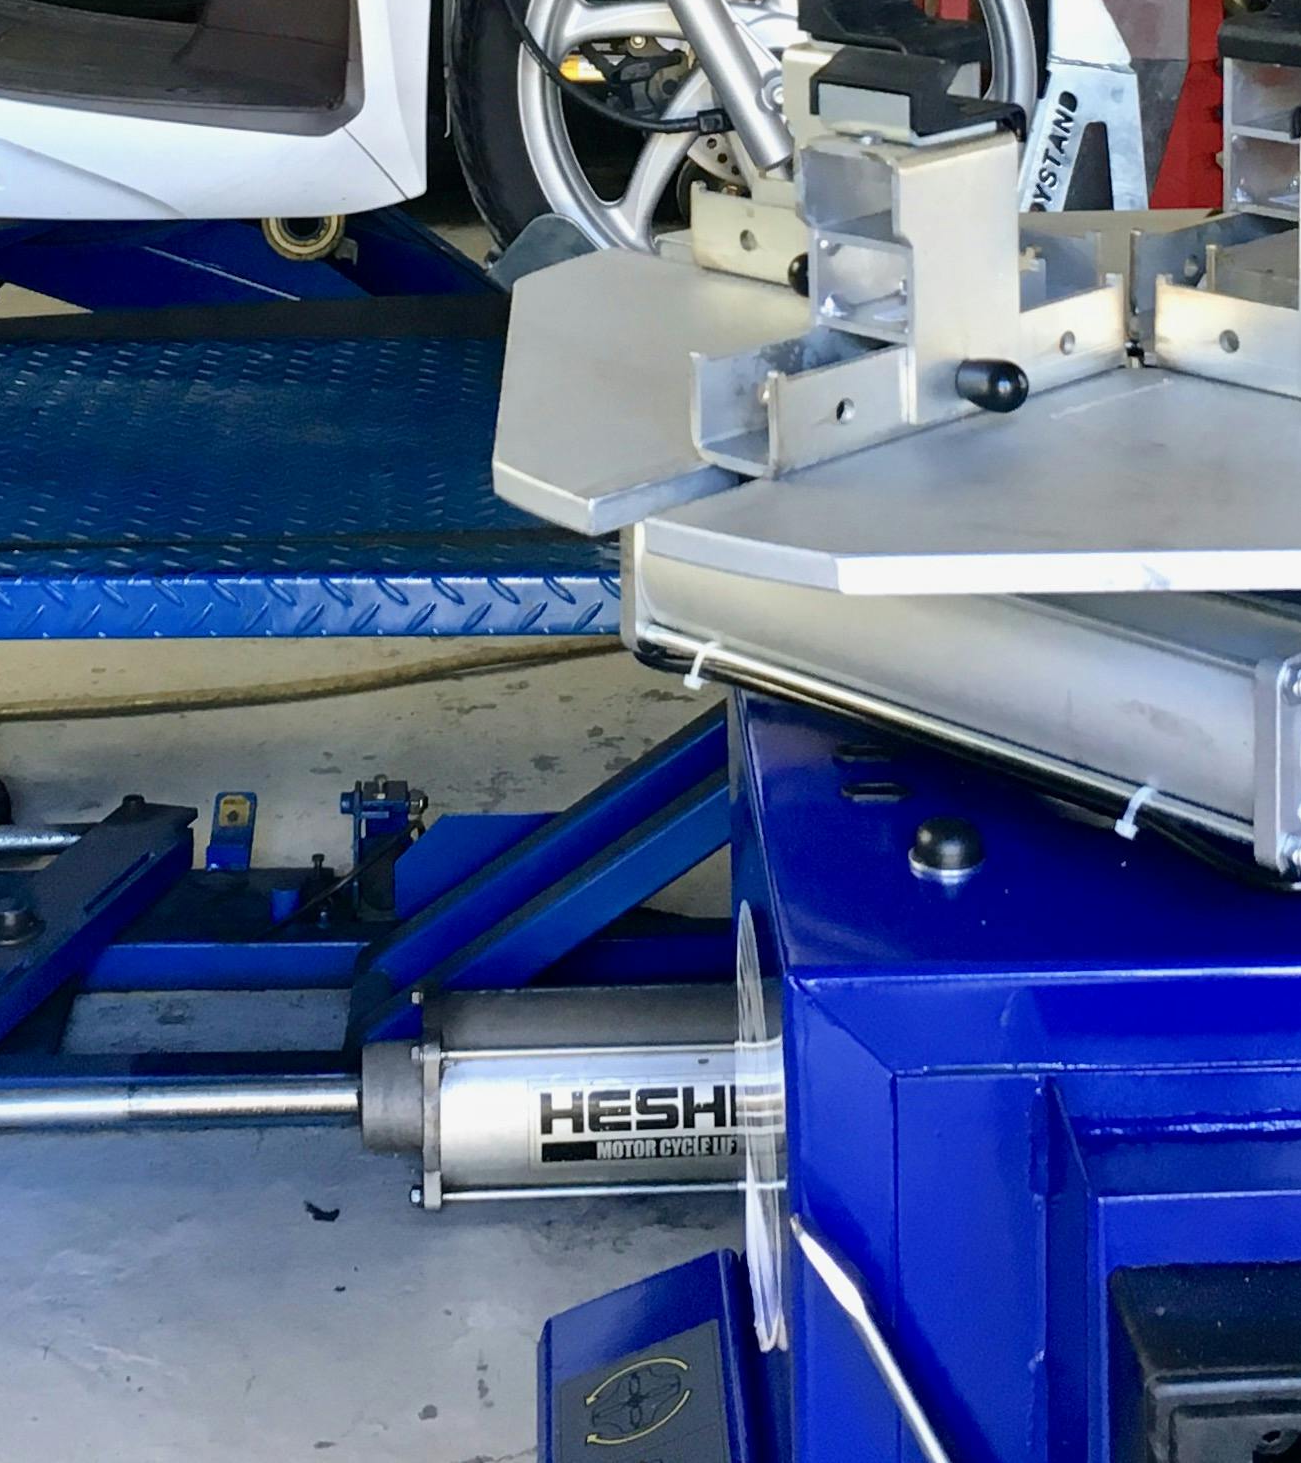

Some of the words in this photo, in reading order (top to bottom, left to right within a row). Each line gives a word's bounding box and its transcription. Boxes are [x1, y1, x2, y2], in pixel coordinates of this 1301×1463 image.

[540, 1084, 737, 1135] HESH
[596, 1139, 656, 1160] MOTOR
[659, 1136, 711, 1158] CYCLE
